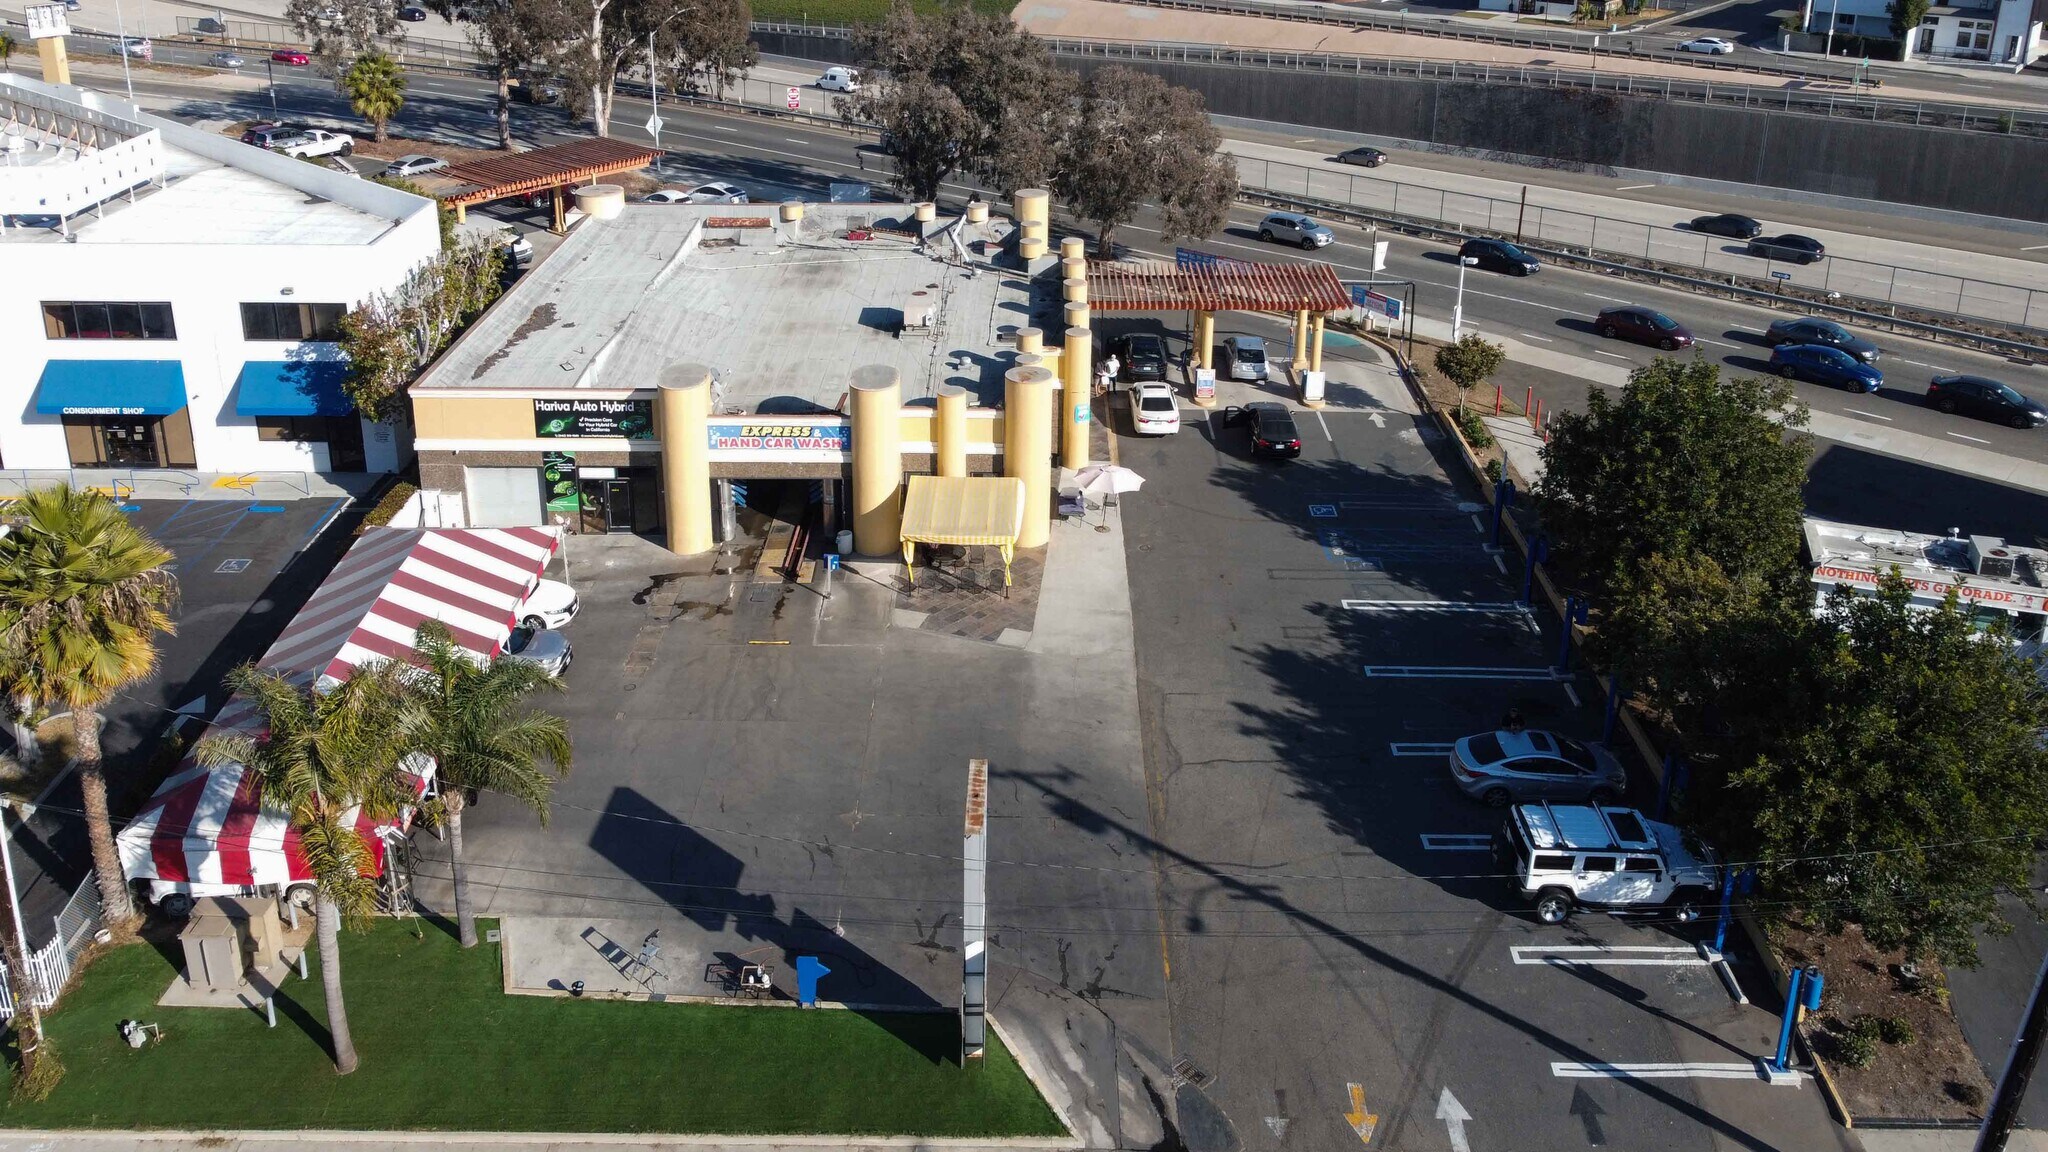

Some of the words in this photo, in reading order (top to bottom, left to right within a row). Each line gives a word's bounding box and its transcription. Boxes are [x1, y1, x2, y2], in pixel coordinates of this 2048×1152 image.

[63, 407, 121, 415] CONSIGNMENT
[122, 407, 145, 415] SHOP
[535, 400, 570, 412] Hariva
[573, 401, 598, 412] Auto
[600, 401, 635, 414] Hybrid
[741, 425, 812, 437] EXPRESS
[813, 428, 822, 438] &
[718, 437, 761, 449] HAND
[764, 438, 795, 449] CAR
[797, 438, 843, 449] WASH
